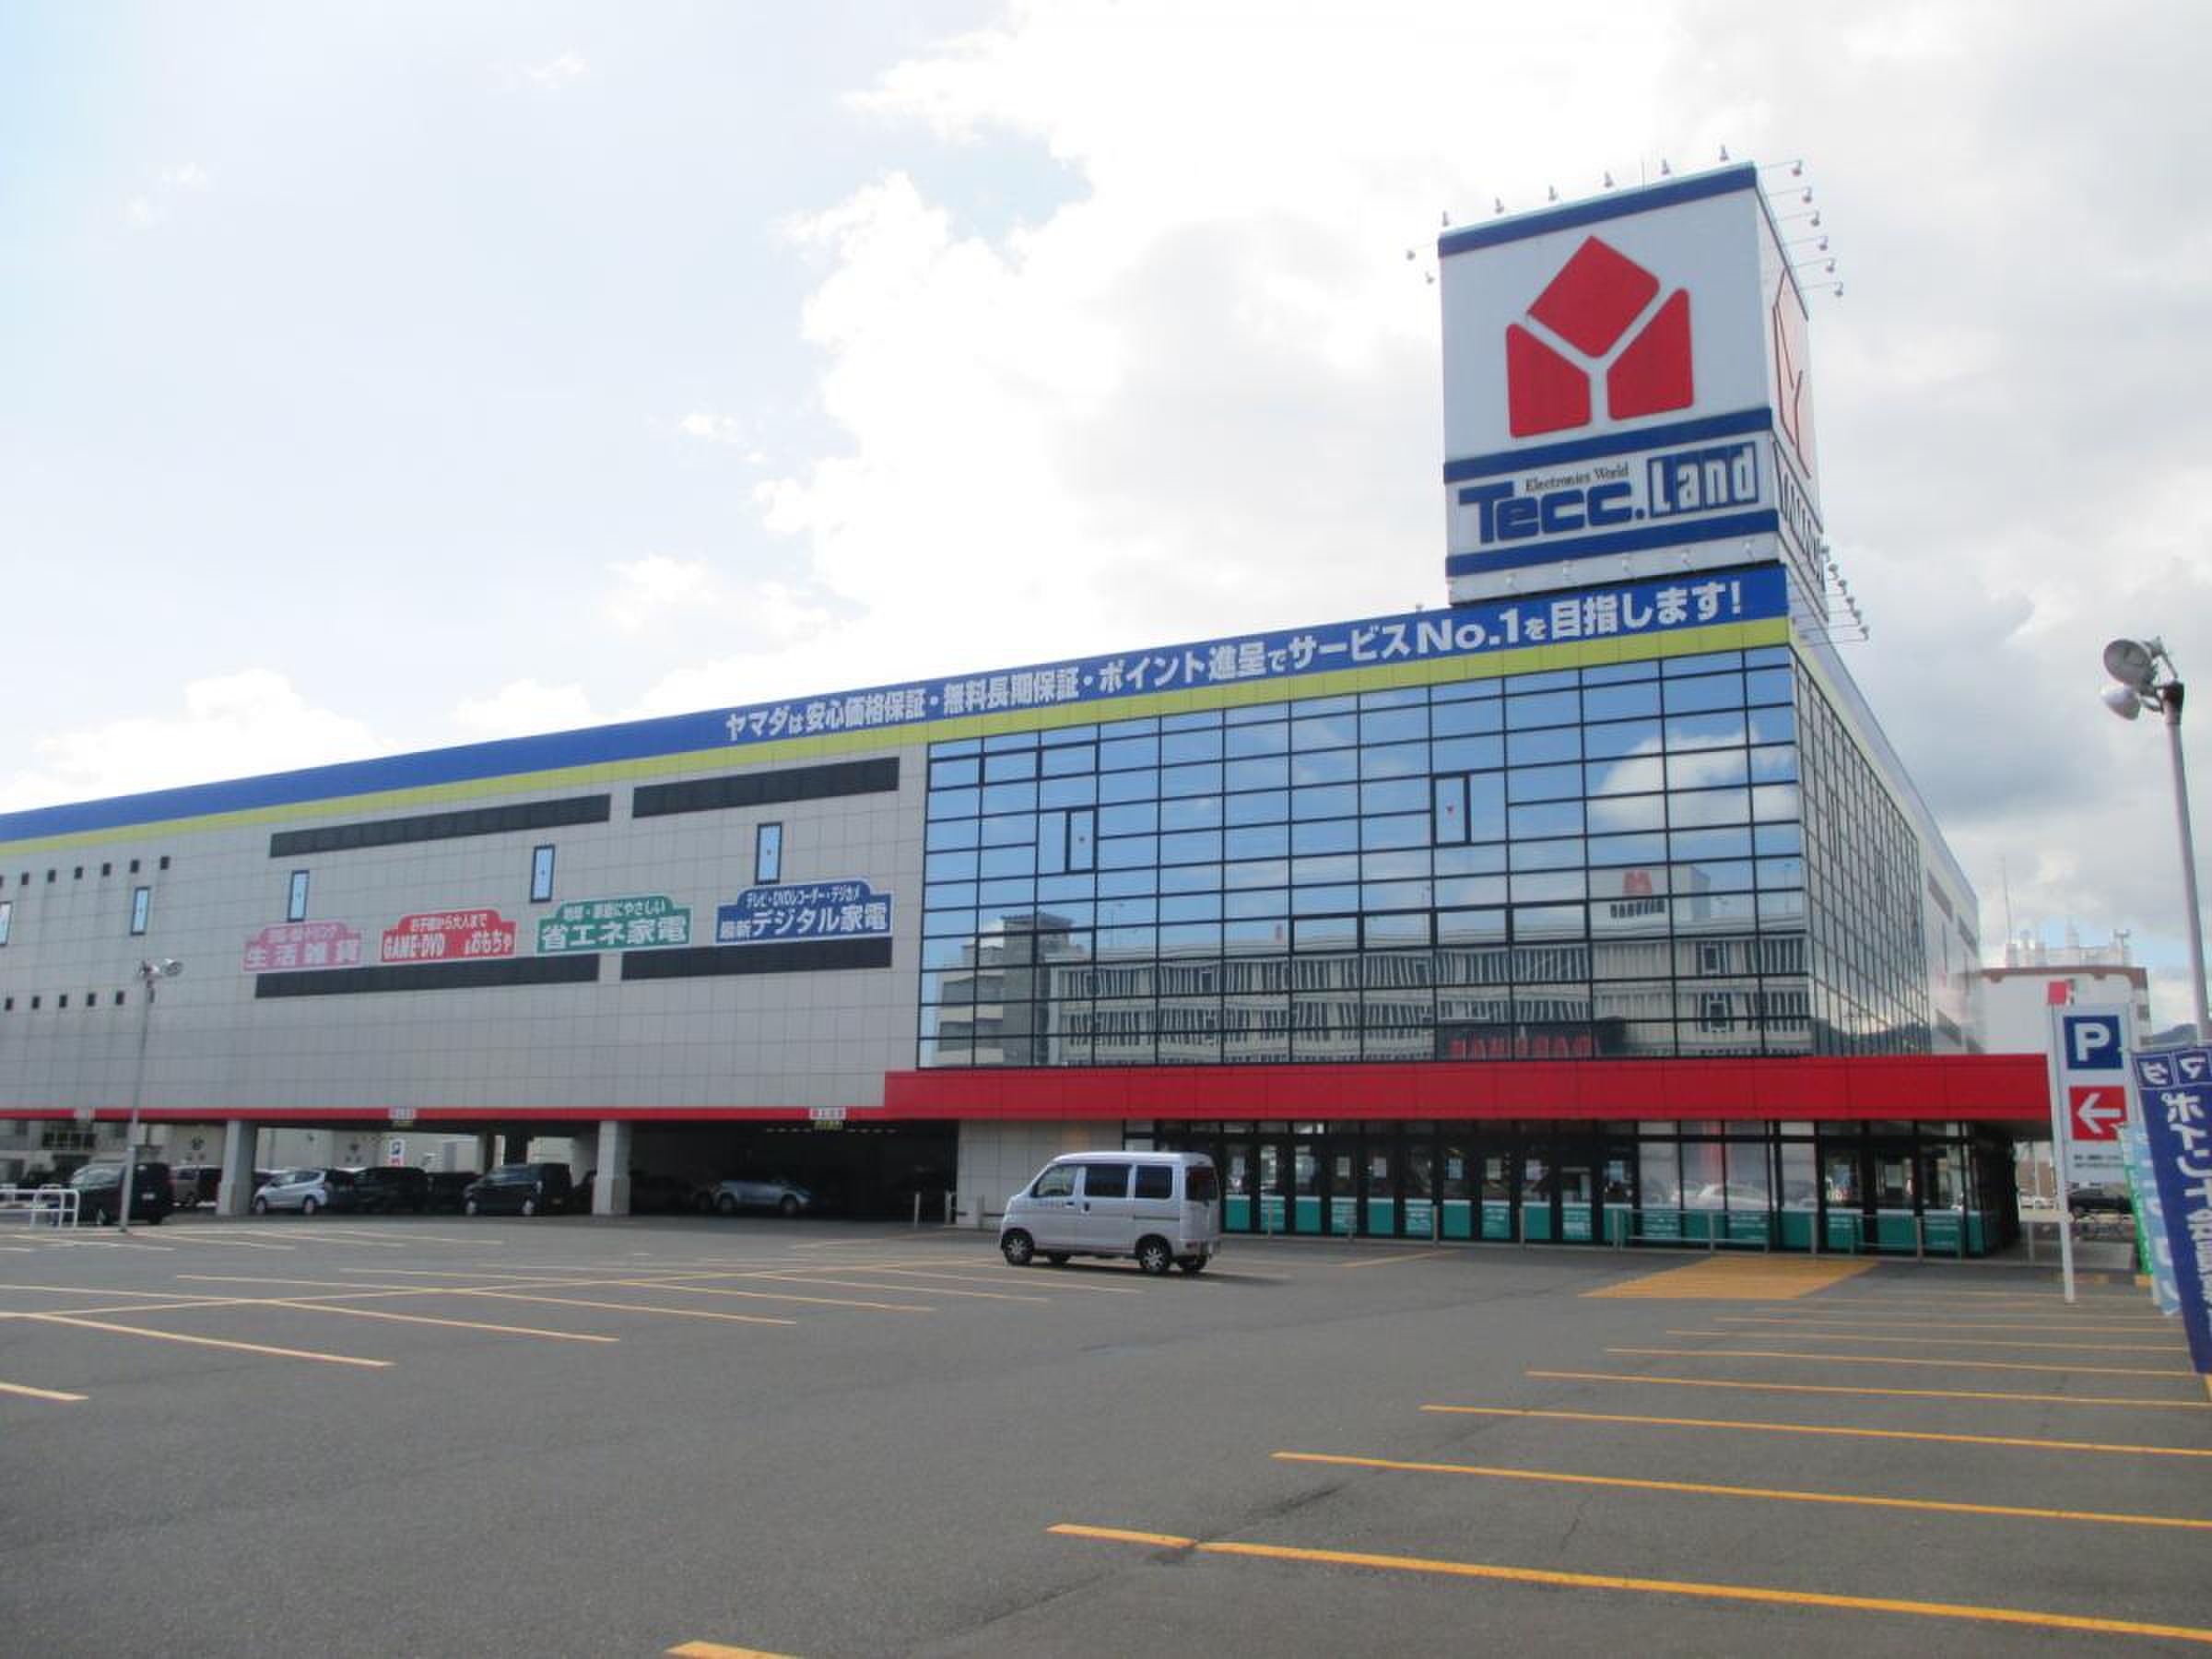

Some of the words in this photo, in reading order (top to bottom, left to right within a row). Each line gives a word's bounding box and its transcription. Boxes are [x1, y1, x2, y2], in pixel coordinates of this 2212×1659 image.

[1524, 472, 1591, 493] Electronics
[1594, 463, 1630, 482] World
[542, 915, 687, 949] 省エネ家電
[2073, 1021, 2111, 1063] P
